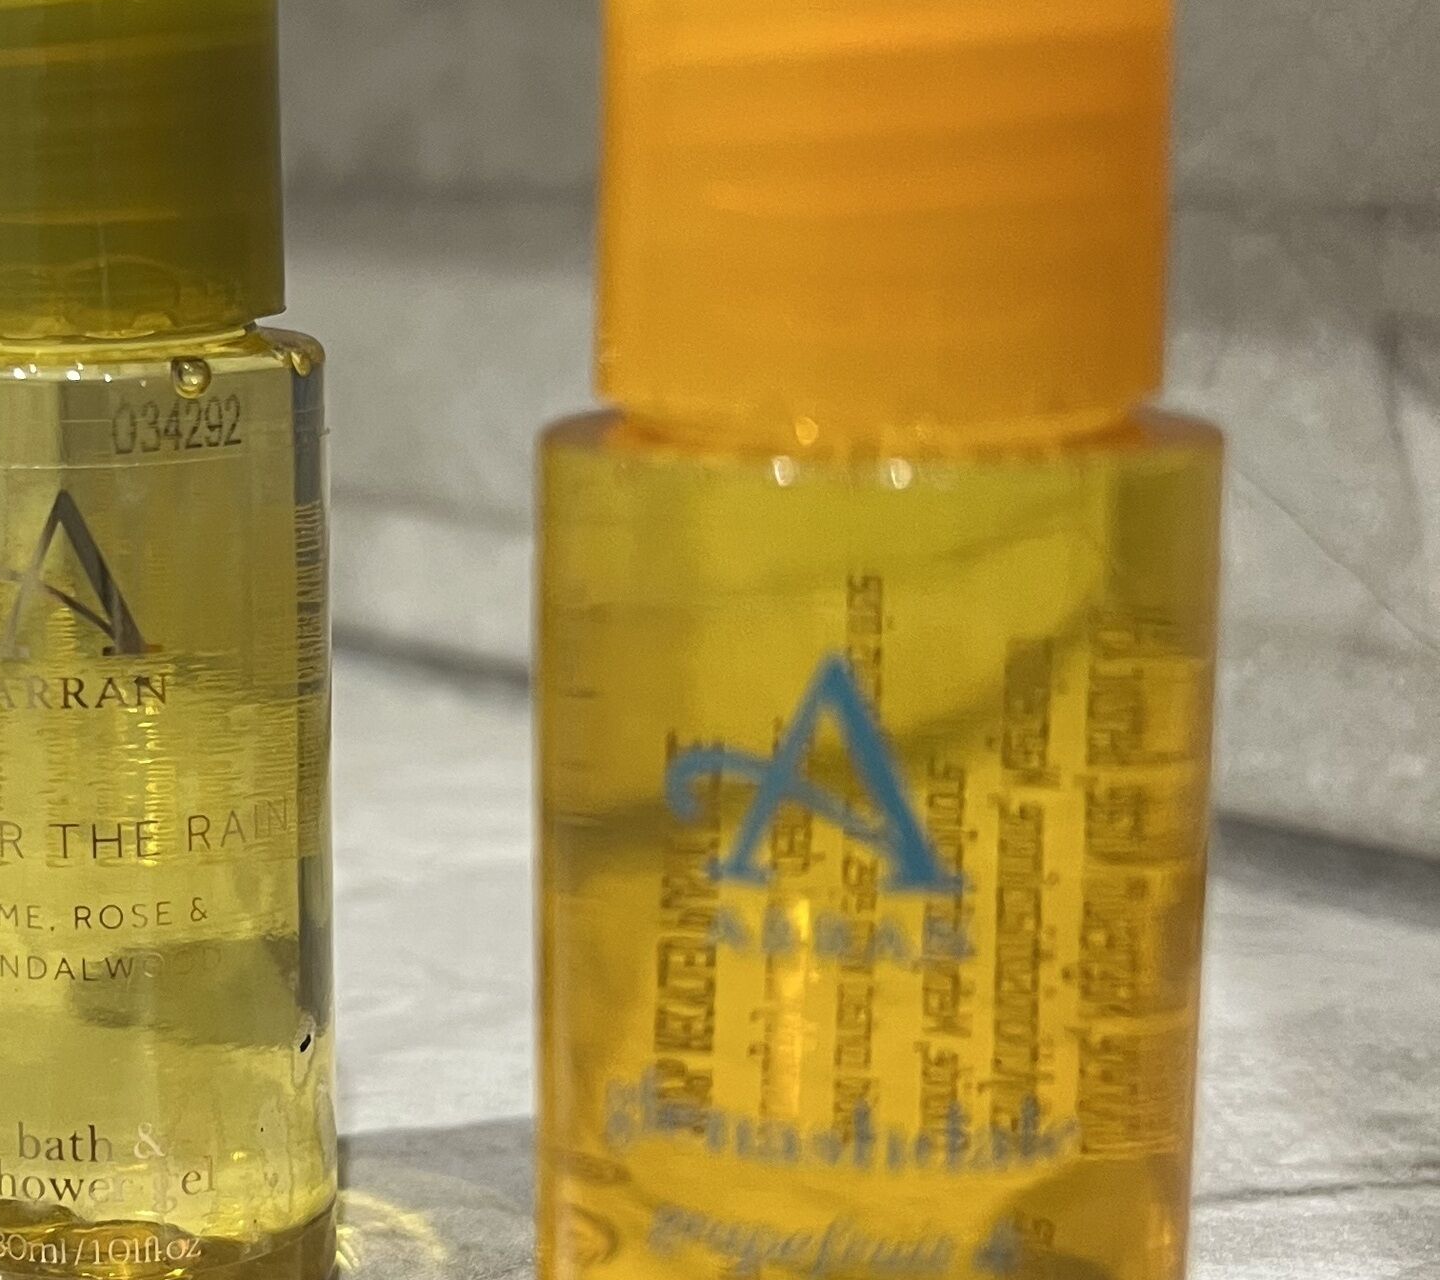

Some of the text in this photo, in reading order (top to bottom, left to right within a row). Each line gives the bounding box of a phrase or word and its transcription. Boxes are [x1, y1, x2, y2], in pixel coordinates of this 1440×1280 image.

[110, 394, 242, 455] 034292
[50, 821, 160, 860] THE
[186, 797, 288, 852] RAIN
[74, 900, 173, 930] ROSE
[190, 897, 209, 922] &
[17, 1121, 166, 1162] bath &
